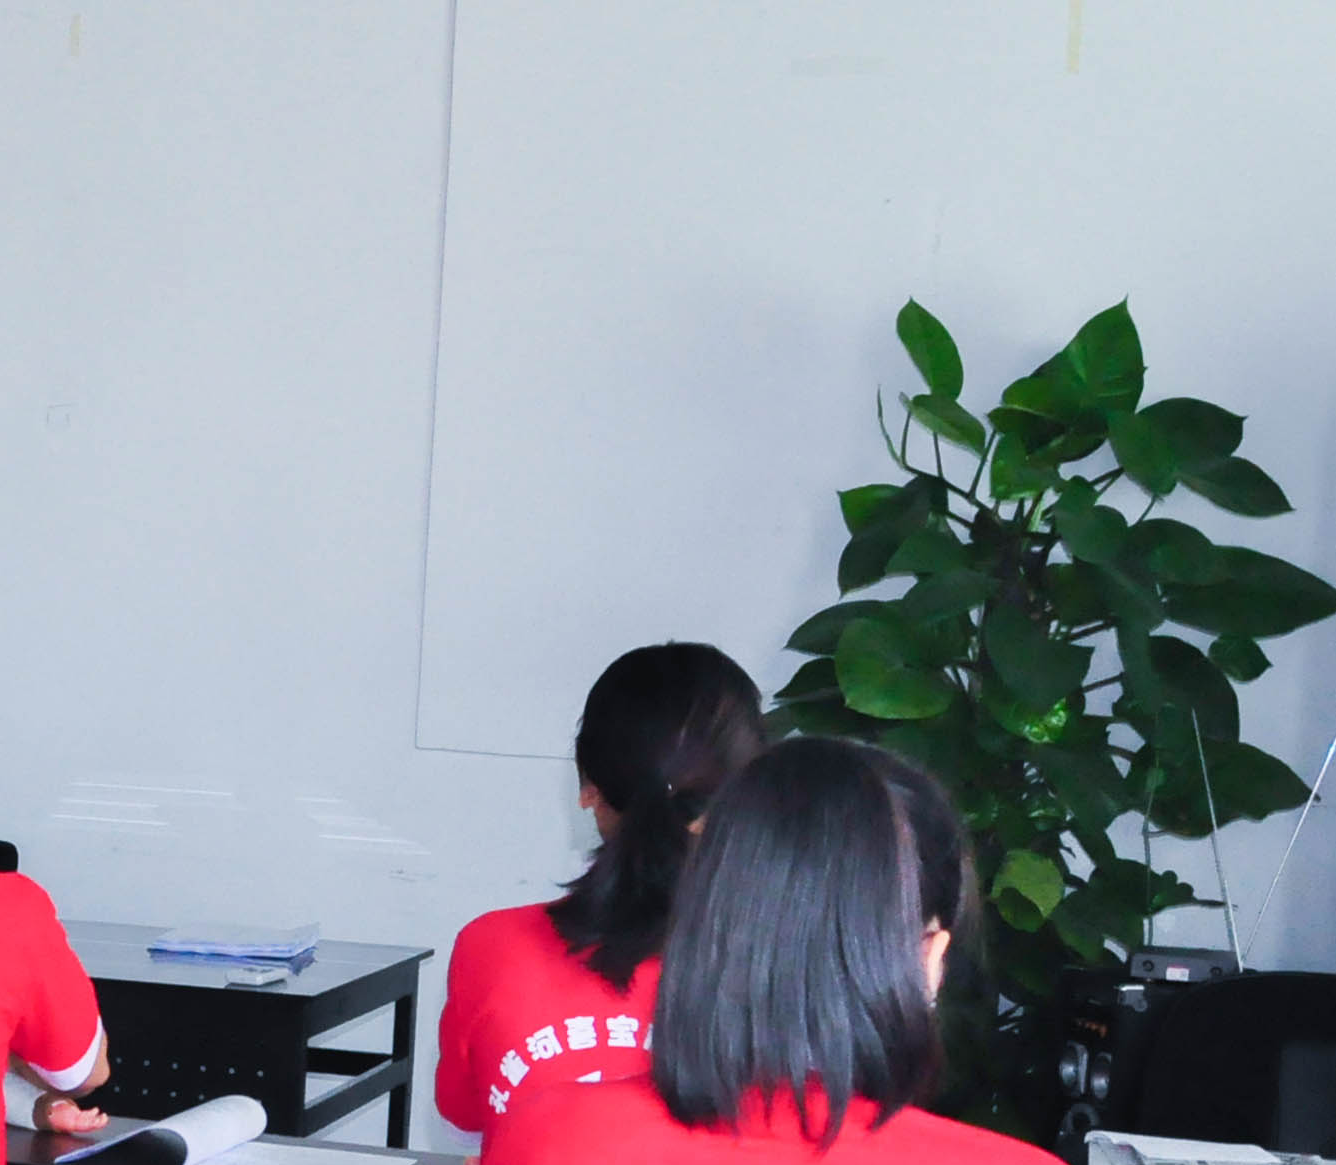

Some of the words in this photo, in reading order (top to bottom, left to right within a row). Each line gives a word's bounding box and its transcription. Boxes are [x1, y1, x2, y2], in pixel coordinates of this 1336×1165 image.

[488, 1013, 654, 1115] 孔雀河喜宝
